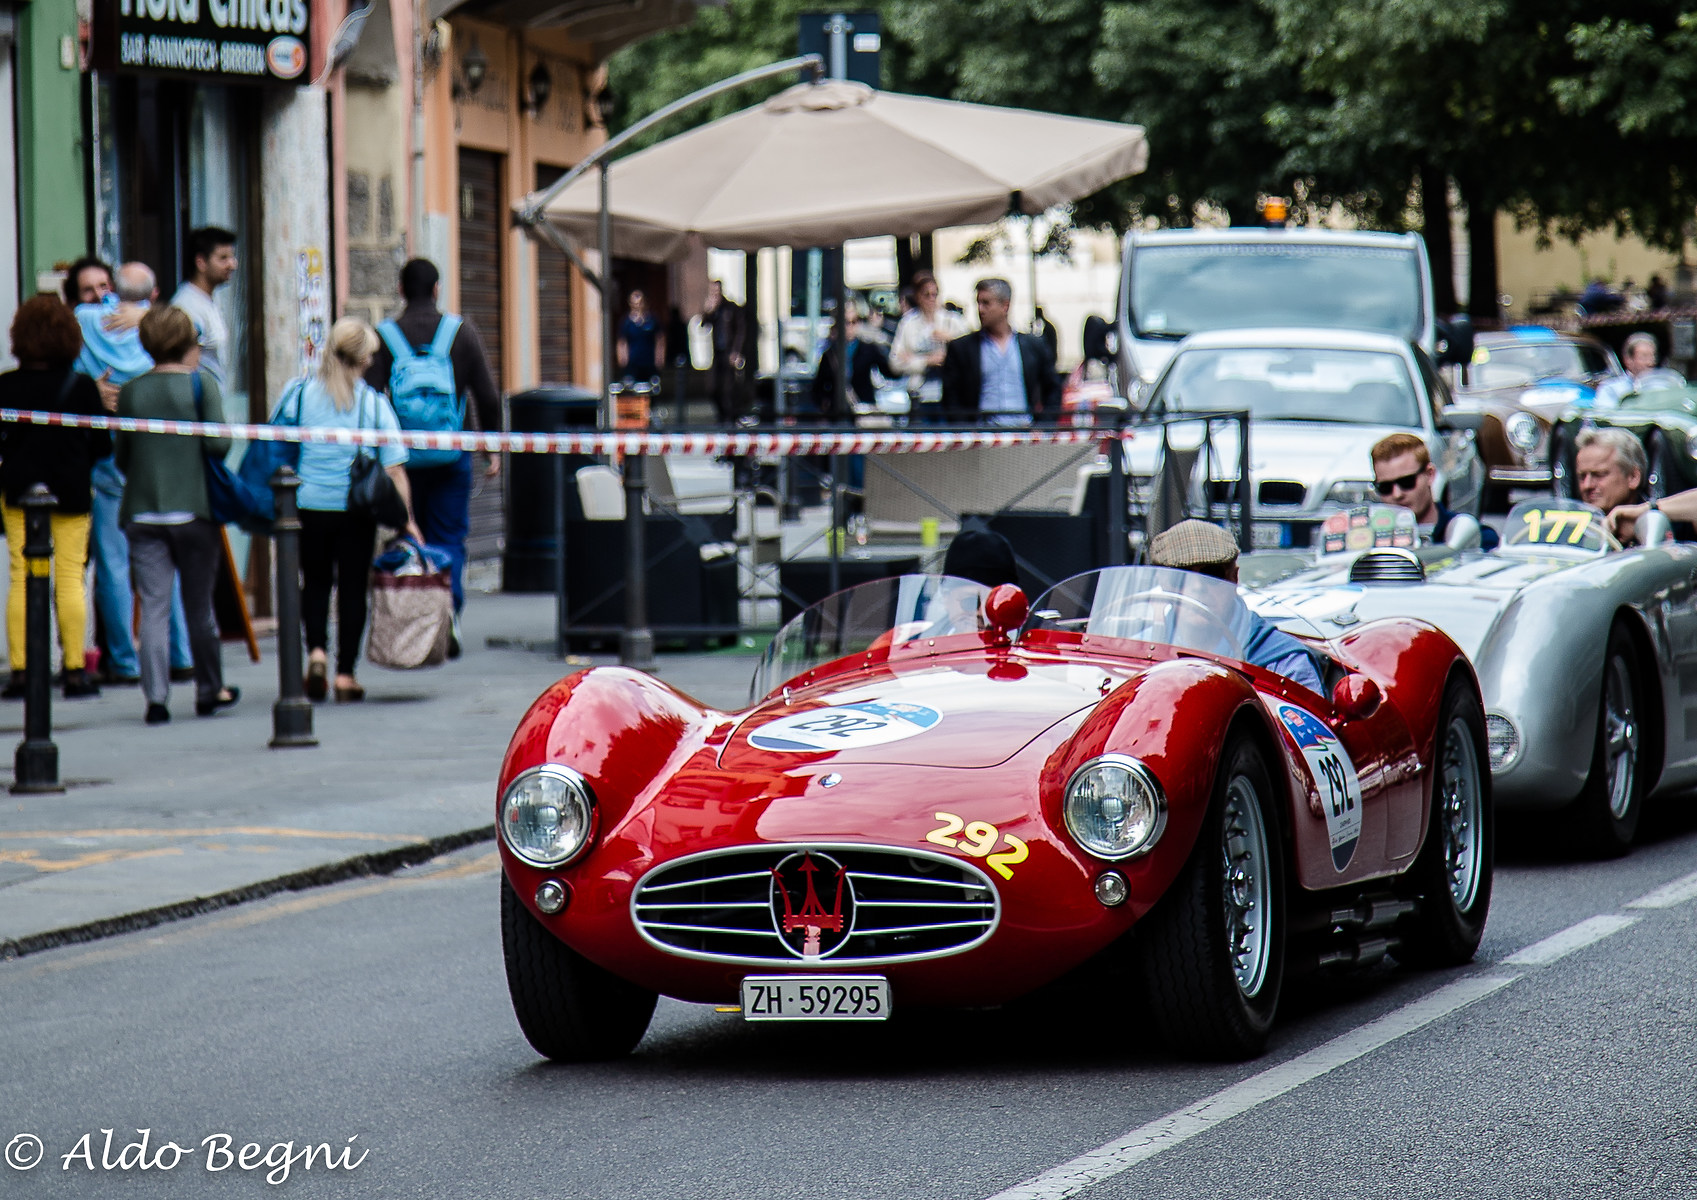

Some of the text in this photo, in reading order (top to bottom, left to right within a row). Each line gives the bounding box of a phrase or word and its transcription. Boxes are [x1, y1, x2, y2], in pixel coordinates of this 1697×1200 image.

[1523, 509, 1593, 544] 177
[789, 714, 888, 738] 292
[1318, 753, 1354, 818] 292
[926, 811, 1030, 881] 292
